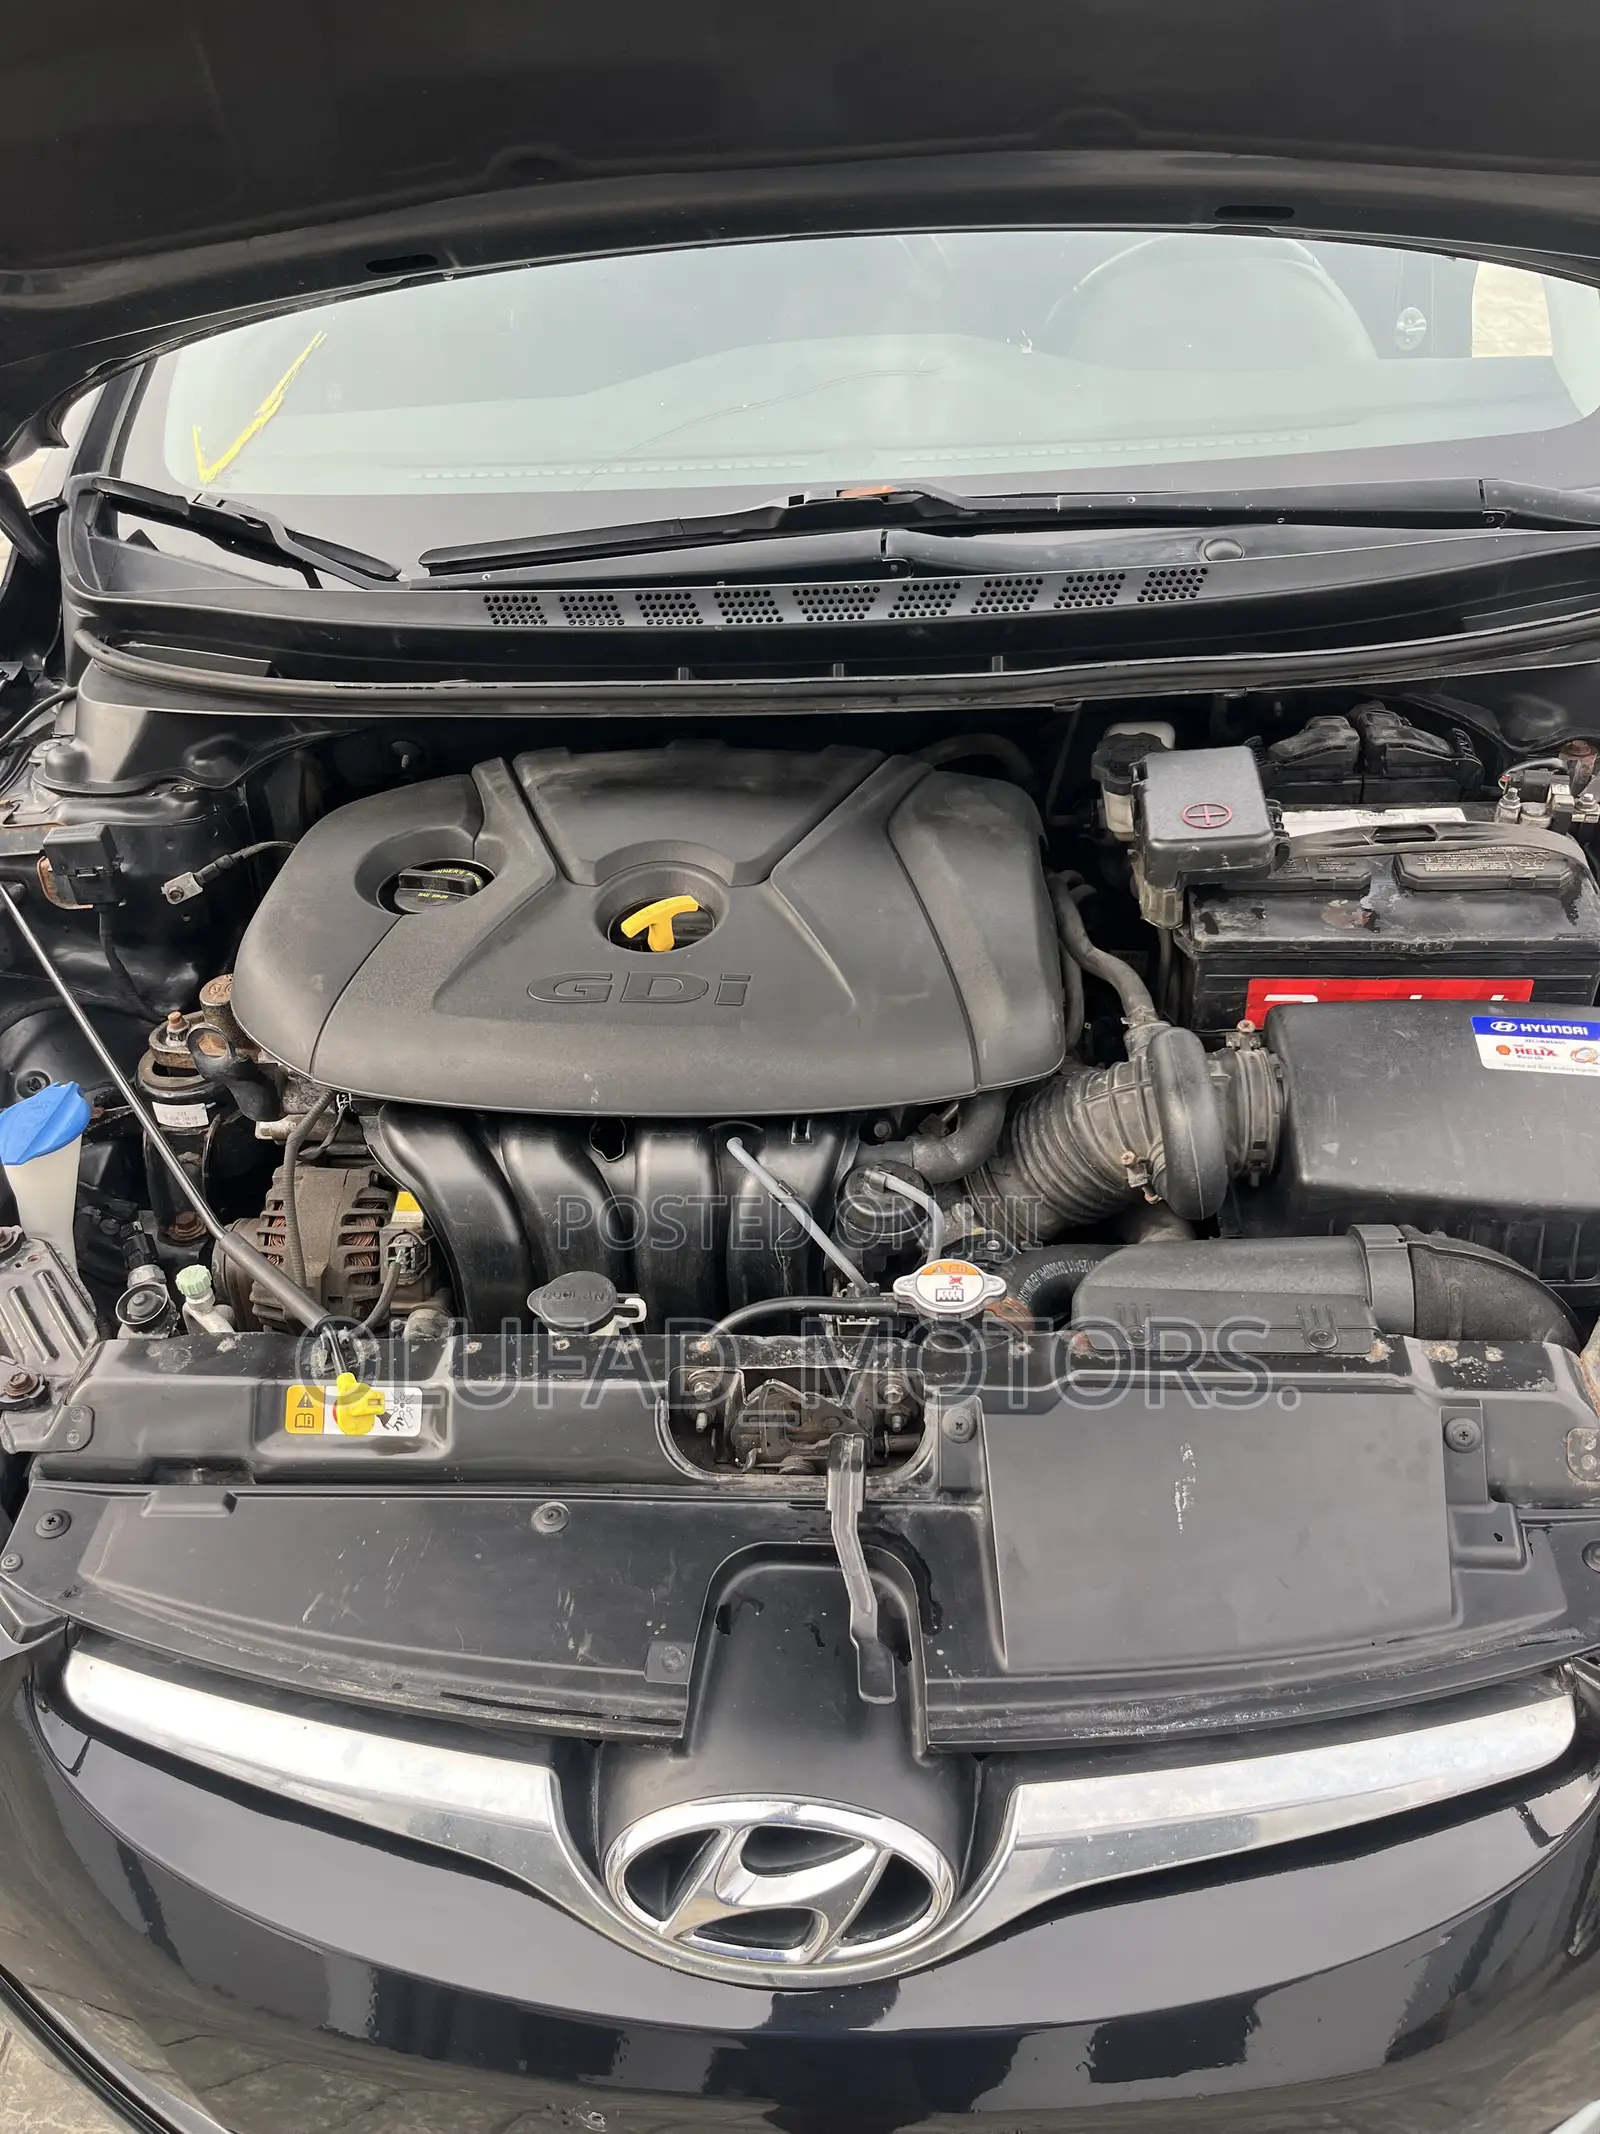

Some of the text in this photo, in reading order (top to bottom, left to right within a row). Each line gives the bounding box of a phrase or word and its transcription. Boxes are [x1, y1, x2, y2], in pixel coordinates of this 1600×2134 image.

[527, 971, 754, 1006] GDi
[1519, 1023, 1588, 1035] HYUNDAI
[1515, 1047, 1558, 1057] HELIX
